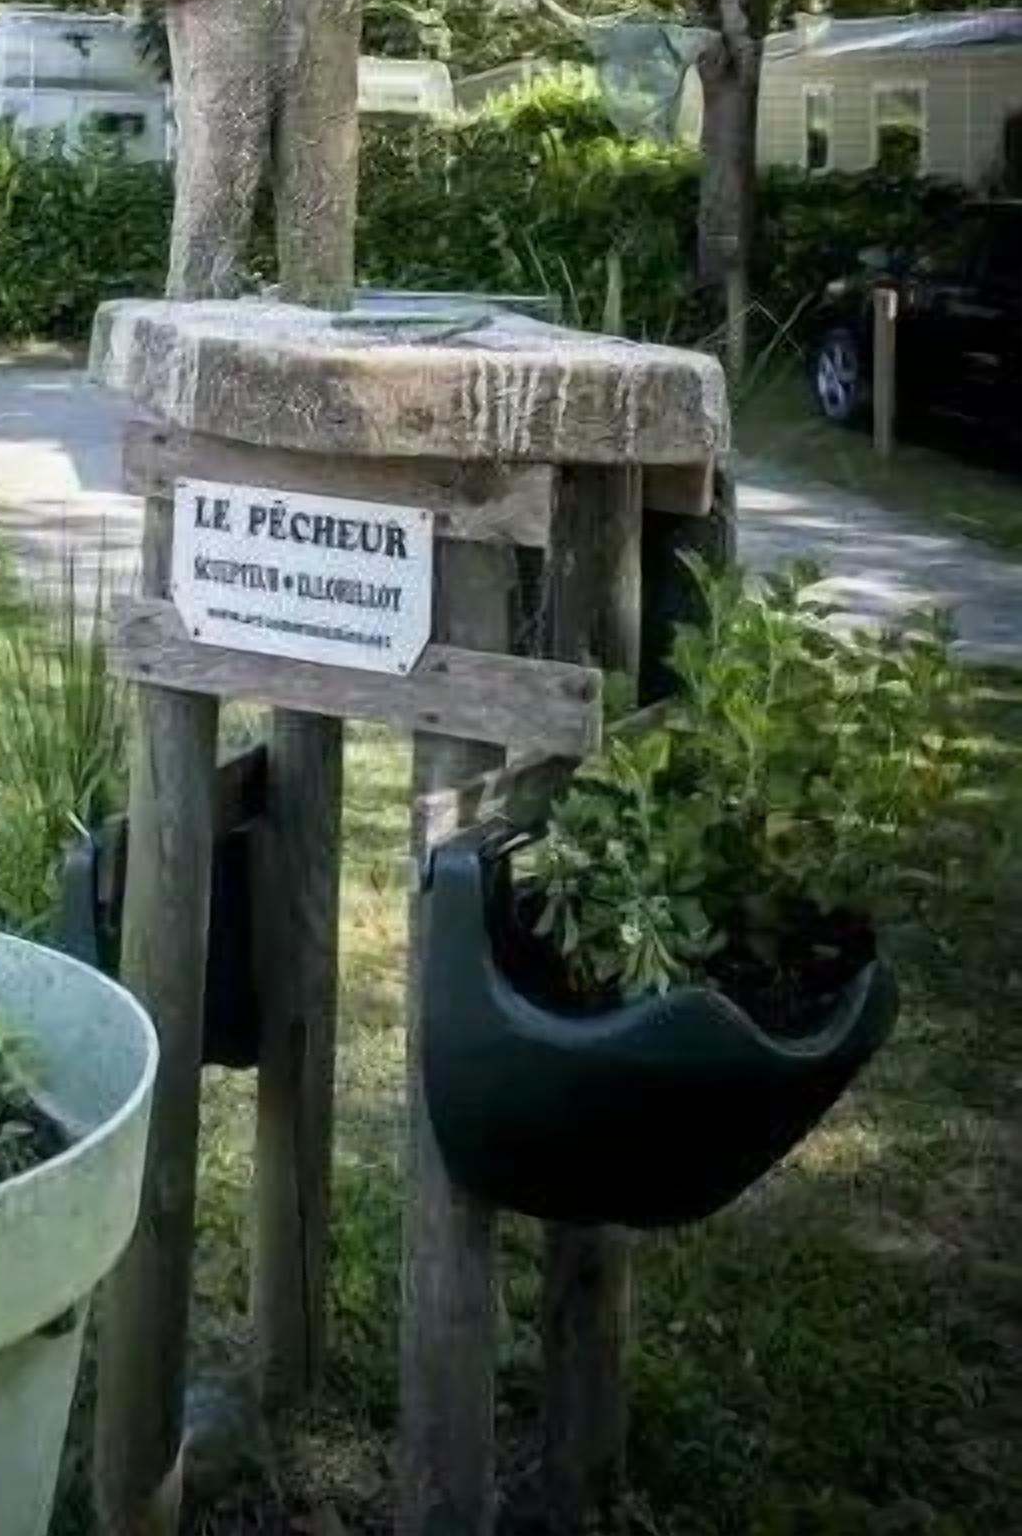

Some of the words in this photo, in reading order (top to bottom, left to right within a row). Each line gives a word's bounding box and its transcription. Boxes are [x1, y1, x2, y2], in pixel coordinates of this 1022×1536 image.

[194, 496, 230, 532] LE
[249, 500, 407, 559] PÊCHEUR
[194, 555, 279, 592] SPTEU
